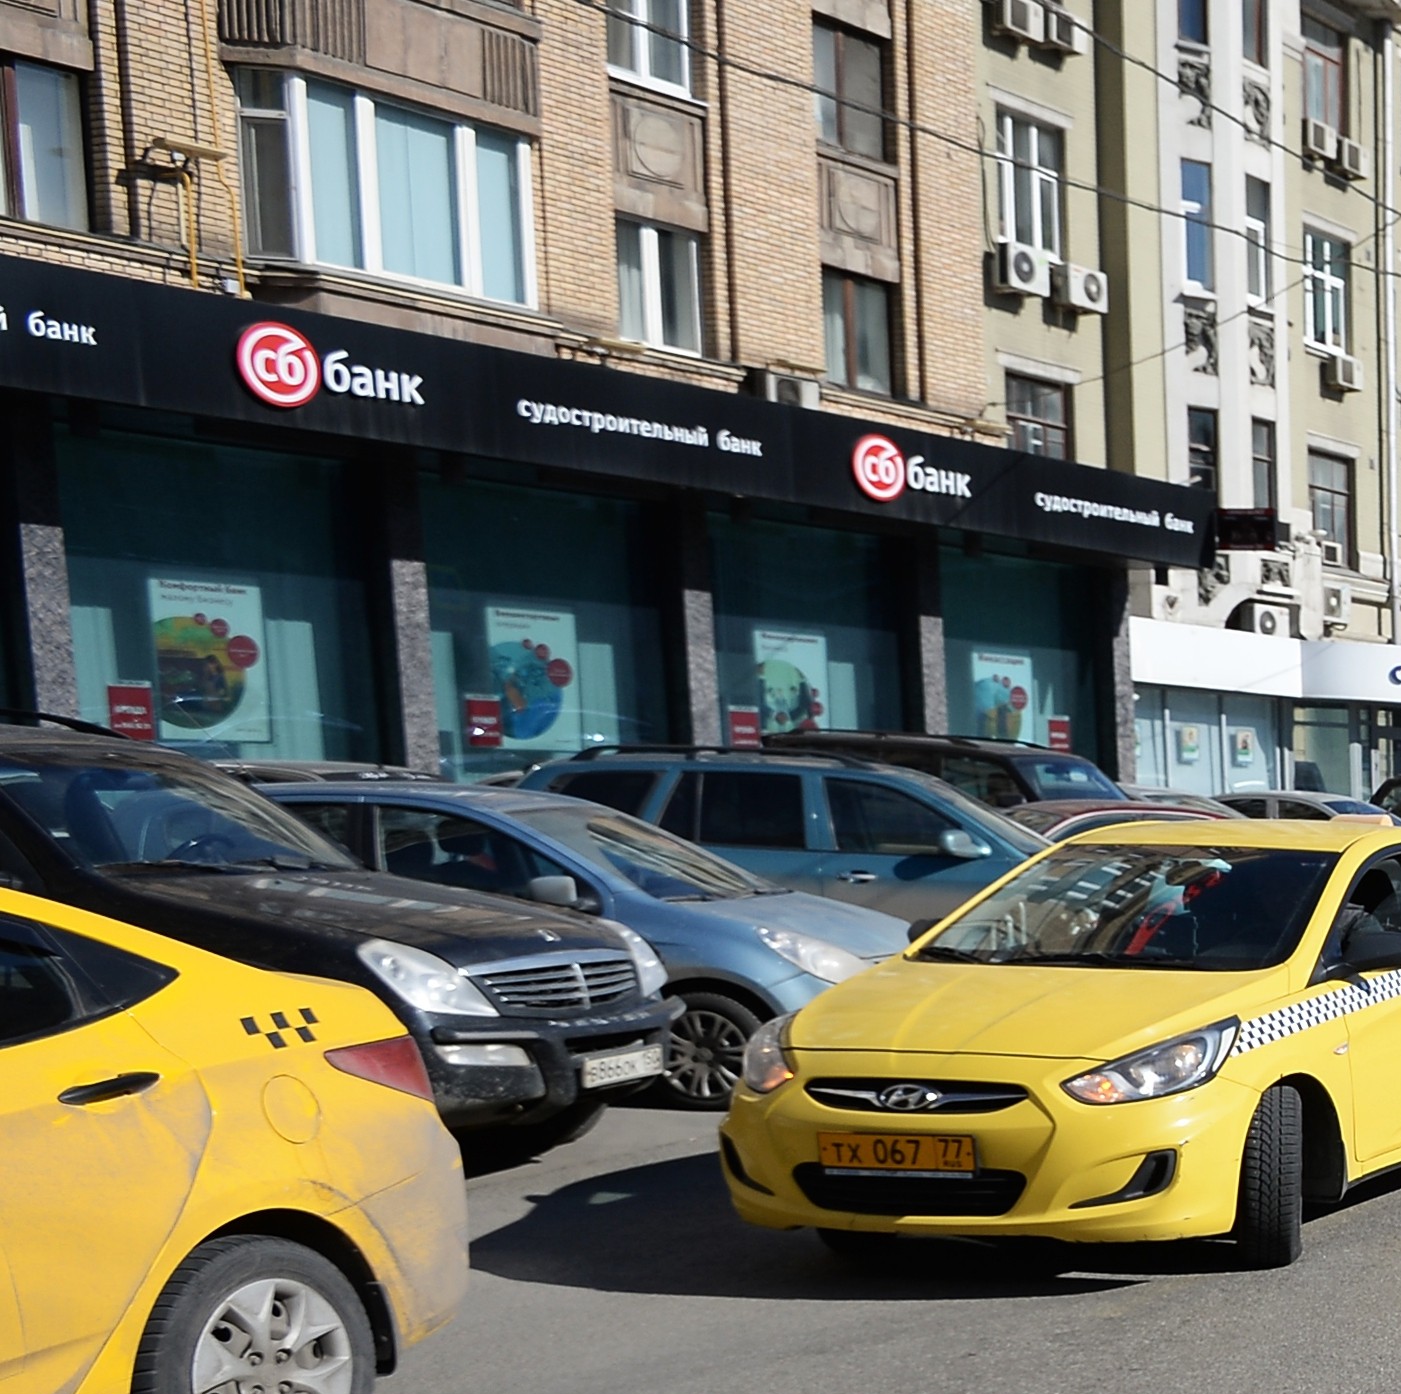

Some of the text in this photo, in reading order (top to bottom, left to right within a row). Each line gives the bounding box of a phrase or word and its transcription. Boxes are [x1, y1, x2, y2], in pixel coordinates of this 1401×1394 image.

[28, 310, 98, 346] банк
[323, 349, 426, 406] банк
[516, 398, 763, 457] судостроительный банк
[906, 454, 973, 499] банк
[1034, 491, 1195, 535] судостроительный банк
[872, 1138, 921, 1165] 067
[936, 1138, 963, 1159] 77
